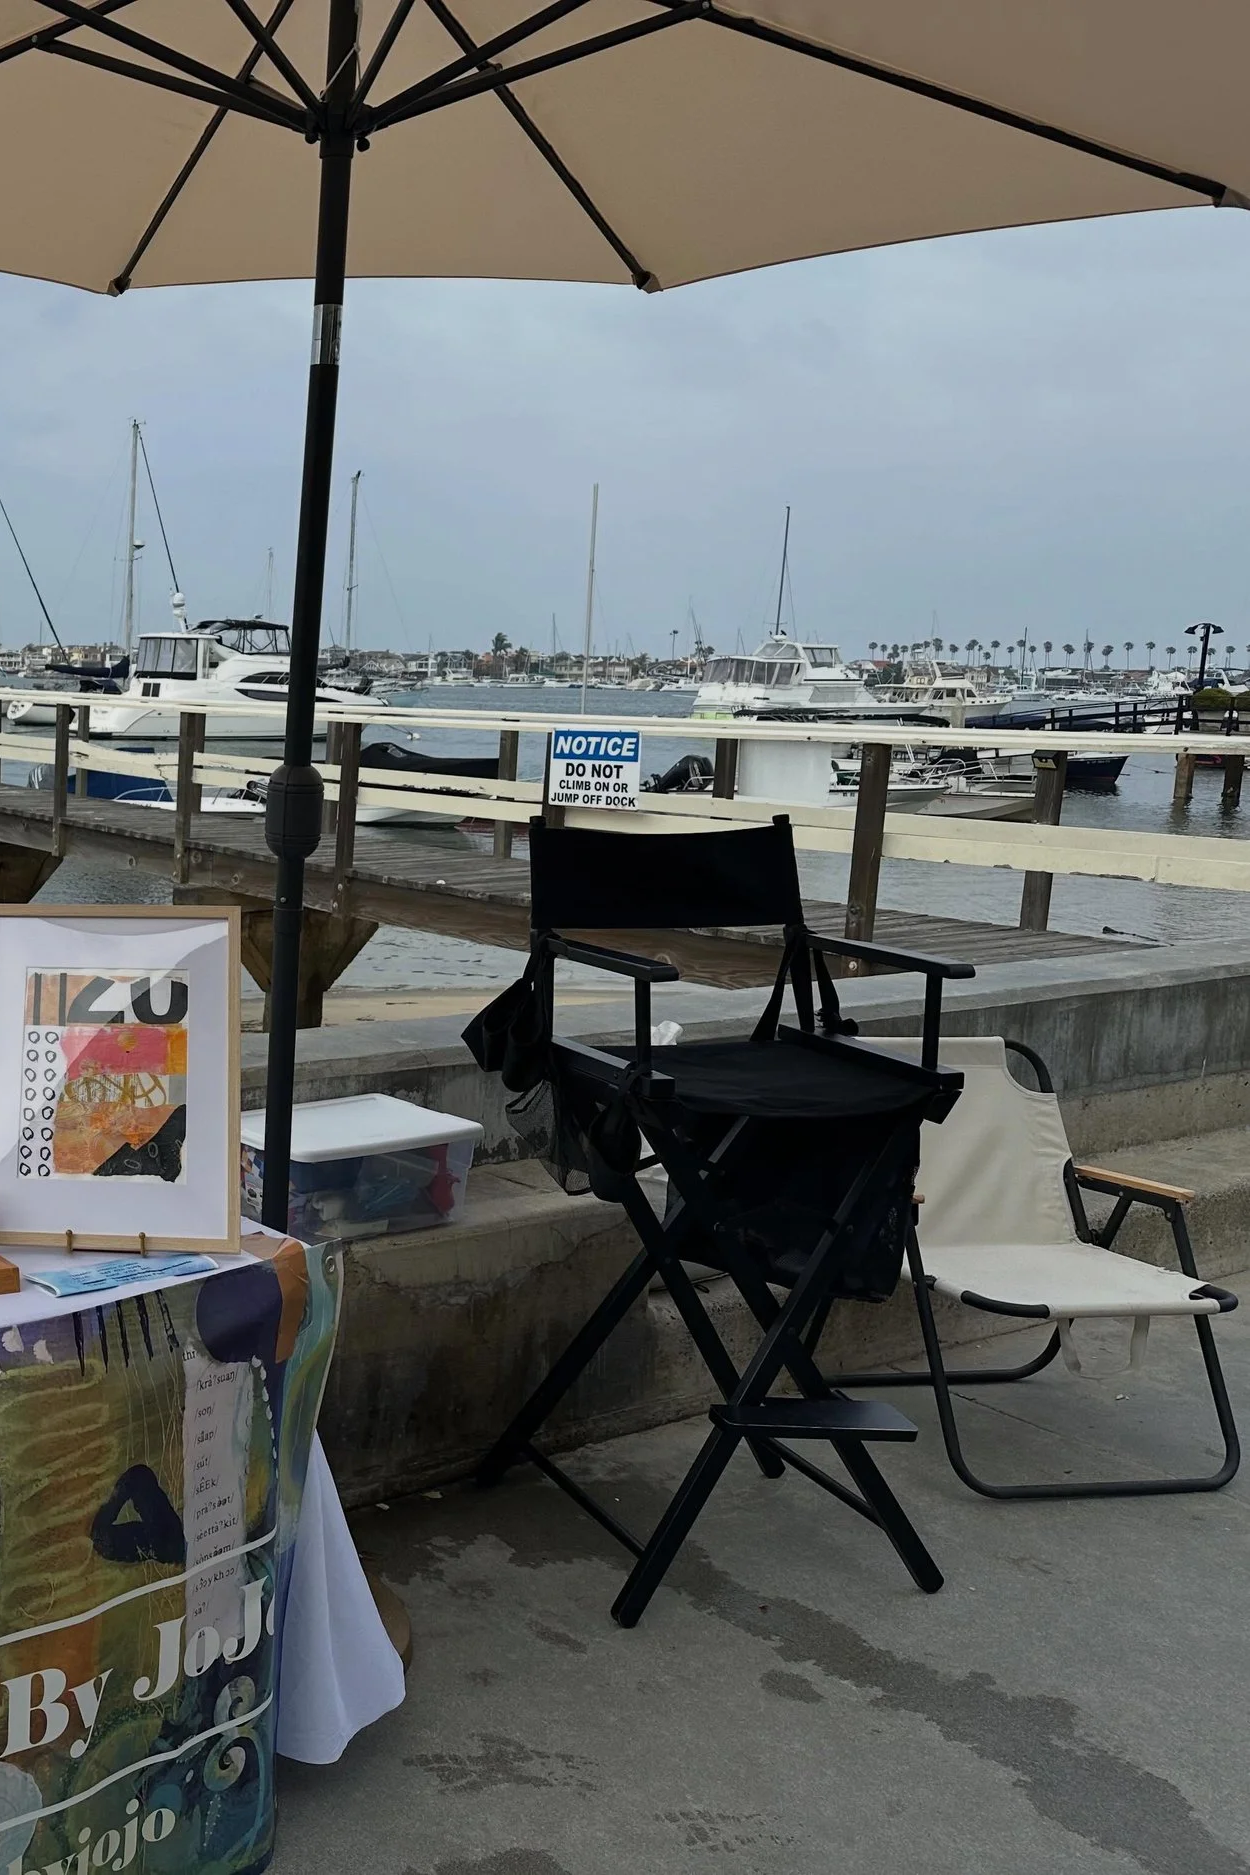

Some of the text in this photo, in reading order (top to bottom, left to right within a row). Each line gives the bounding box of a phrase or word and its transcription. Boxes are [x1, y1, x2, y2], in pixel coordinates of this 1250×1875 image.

[555, 736, 637, 757] NOTICE
[565, 763, 623, 779] DO NOT
[559, 780, 628, 793] CLIMB ON OR
[551, 792, 636, 807] JUMP OFF DOCK
[0, 1667, 113, 1759] By
[133, 1575, 275, 1701] JoJ
